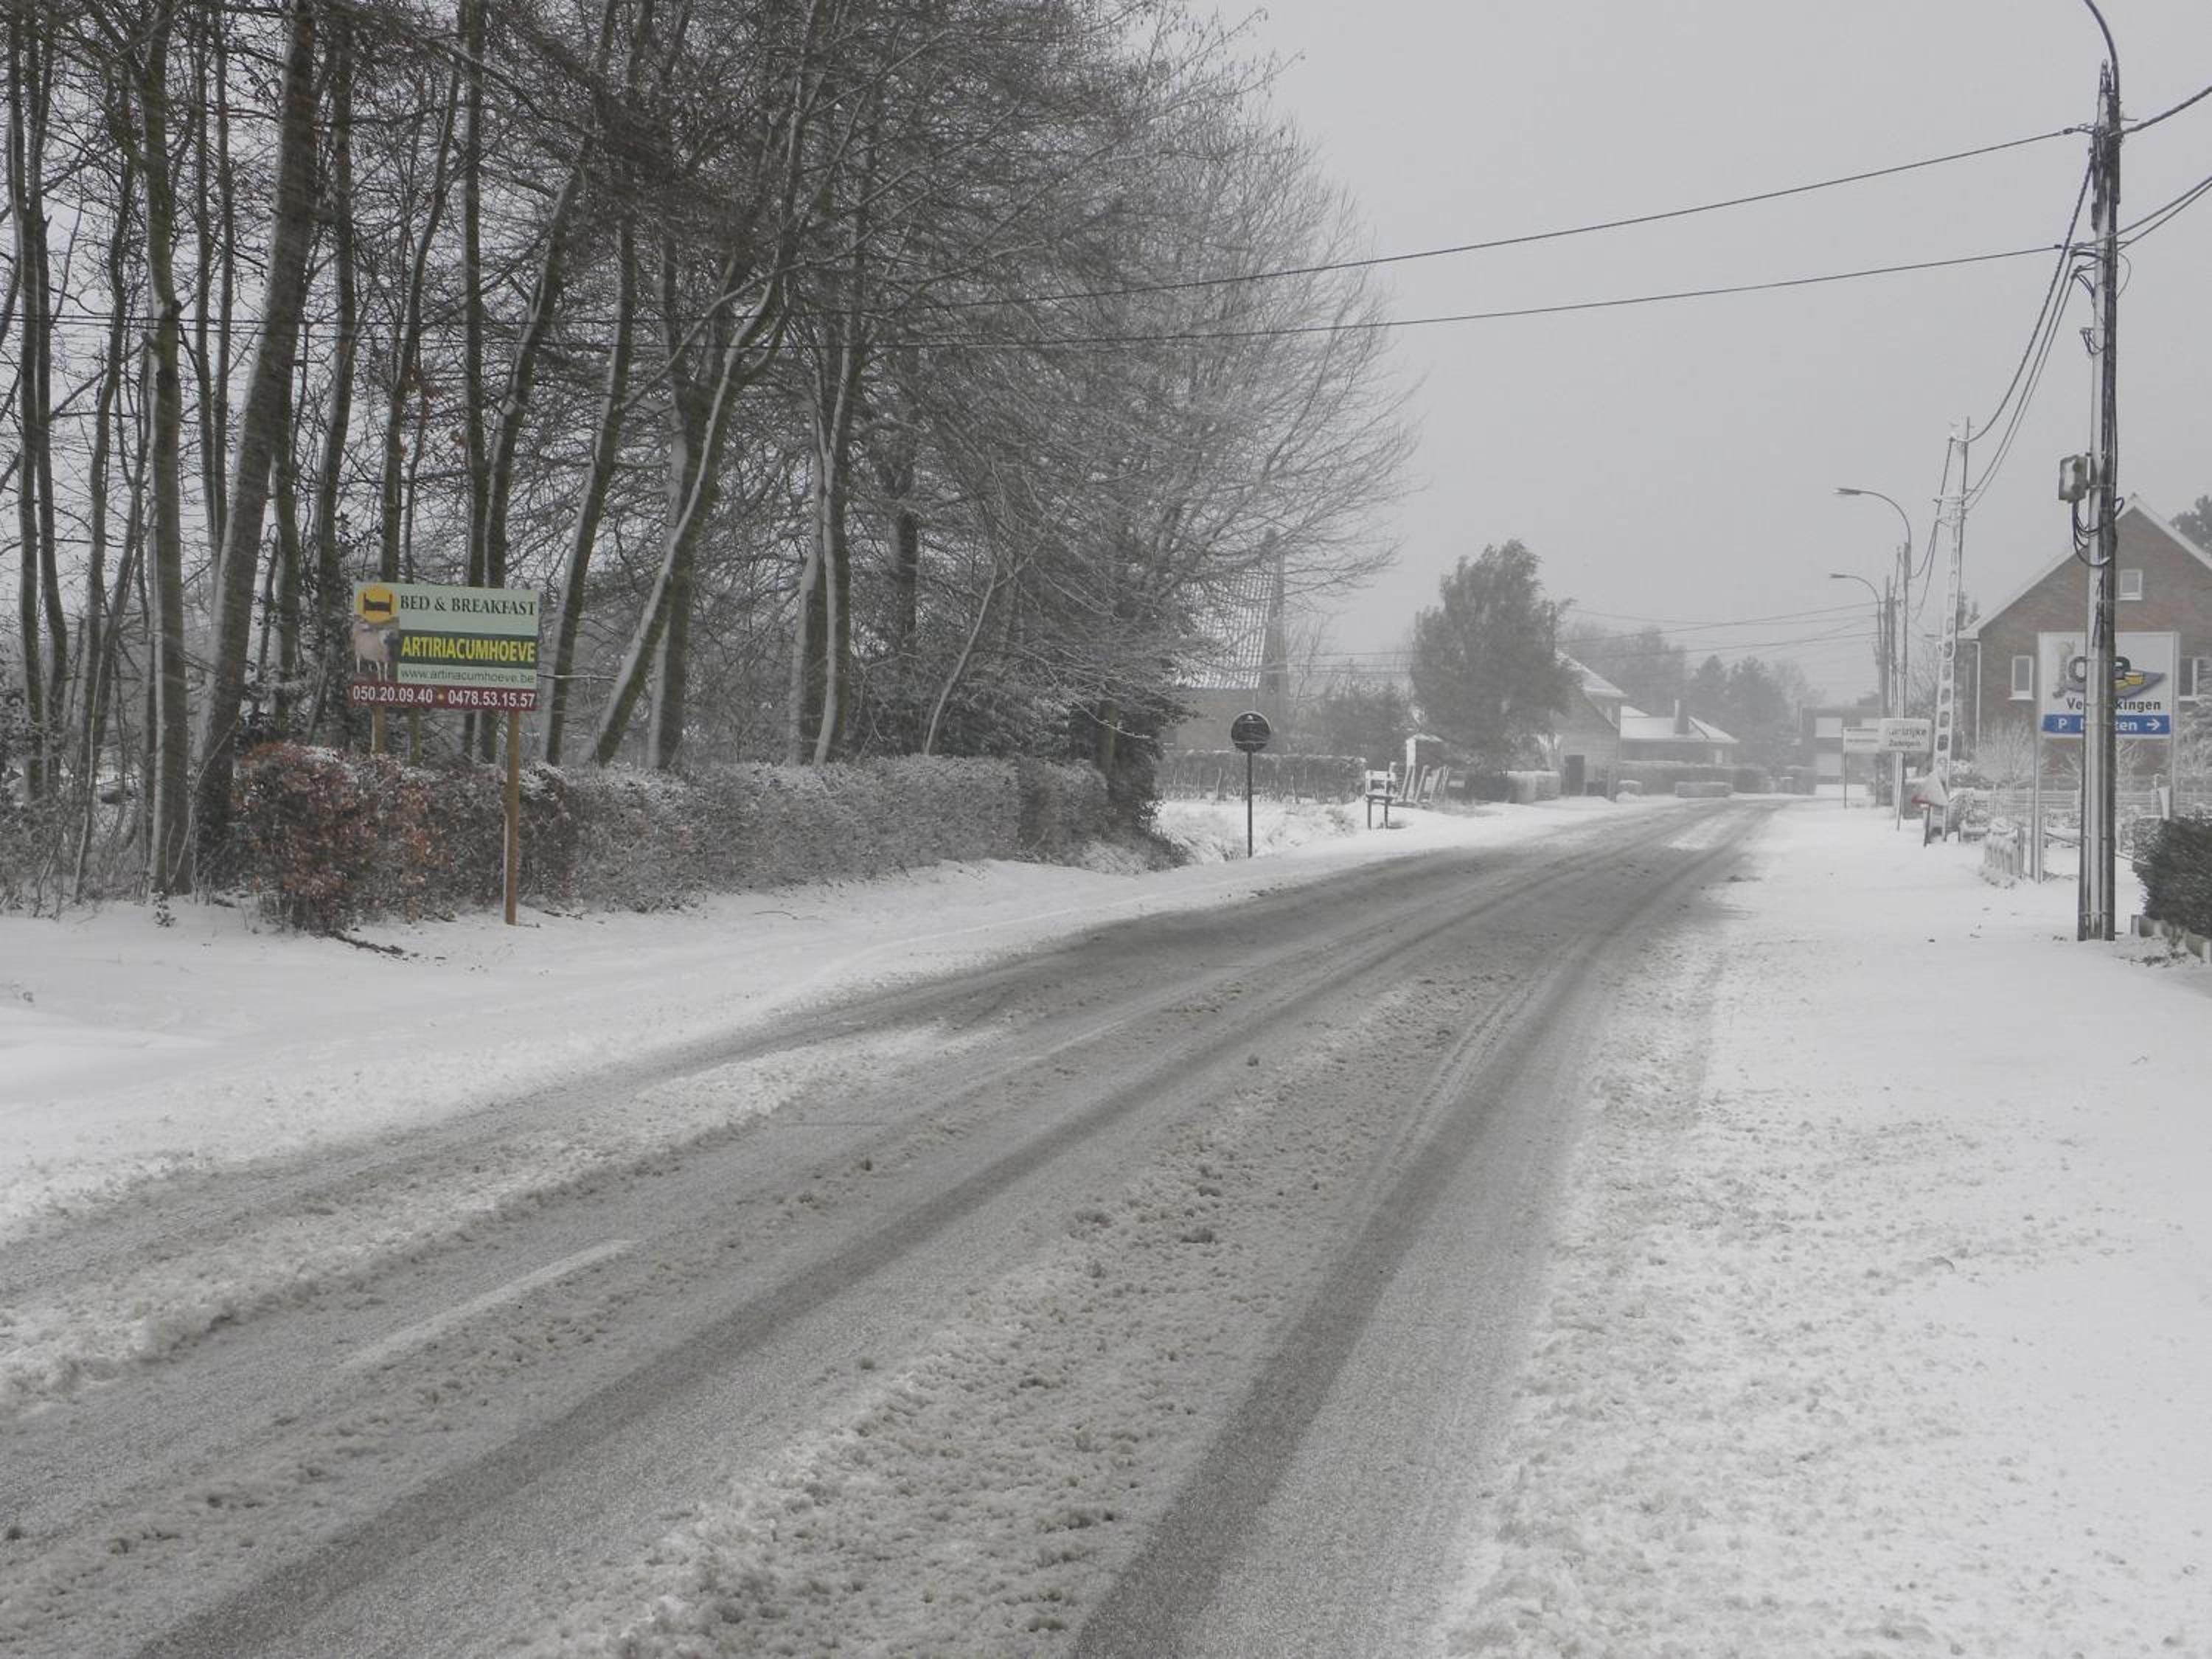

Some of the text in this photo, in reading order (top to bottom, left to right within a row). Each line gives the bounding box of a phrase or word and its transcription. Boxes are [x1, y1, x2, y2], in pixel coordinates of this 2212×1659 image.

[400, 595, 536, 616] BED & BREAKFAST
[400, 636, 536, 662] ARTIRIACUMHOEVE
[352, 686, 536, 707] 050.20.09.40 0478.53.15.57
[2066, 697, 2161, 712] Vekingen
